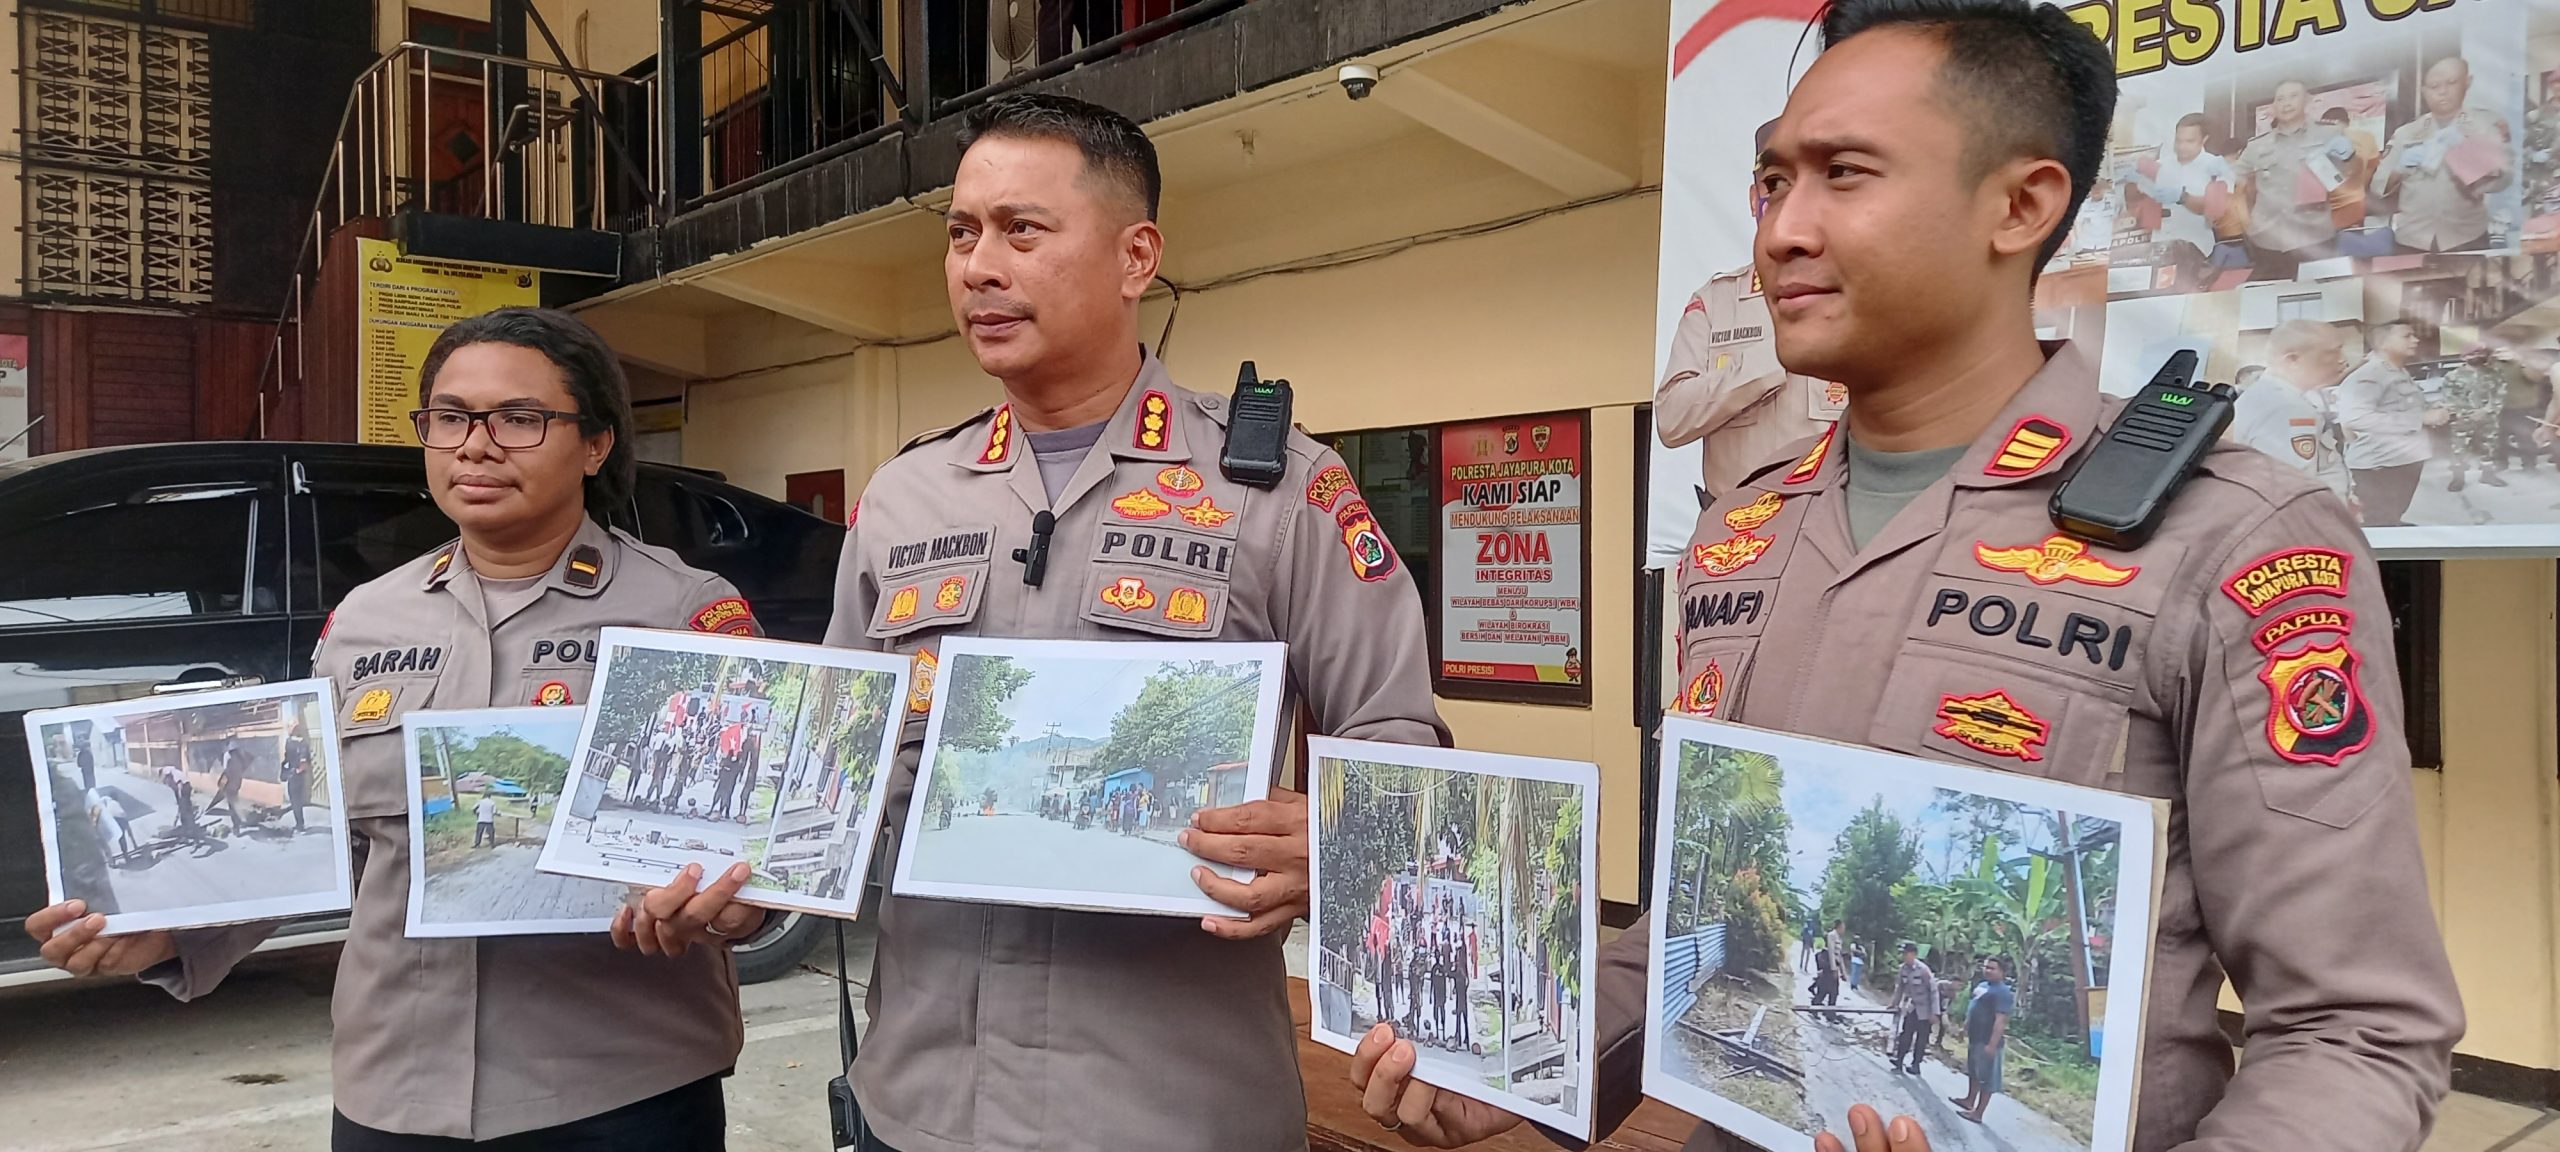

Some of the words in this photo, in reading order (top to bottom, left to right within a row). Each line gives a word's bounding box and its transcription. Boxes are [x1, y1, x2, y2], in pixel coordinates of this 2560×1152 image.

[1451, 463, 1496, 481] POLRESTA
[1499, 460, 1547, 477] JAYAPURA
[1548, 458, 1574, 475] KOTA
[1463, 482, 1512, 506] KAMI
[1517, 479, 1561, 504] SIAP
[1339, 503, 1365, 522] PAPUA
[1451, 511, 1508, 528] MENDUKUNG
[1510, 507, 1580, 526] PELAKSANAAN
[888, 541, 928, 569] VICTOR
[929, 532, 988, 561] MACKBON
[1101, 531, 1229, 573] POLRI
[1476, 531, 1552, 564] ZONA
[1476, 568, 1552, 581] INTEGRITAS
[2234, 553, 2342, 598] POLRESTA
[1497, 586, 1527, 596] MENUJU
[2249, 571, 2309, 608] JAYAPURA
[1479, 621, 1508, 630] WILAYAH
[1927, 588, 2132, 671] POLRI
[2265, 612, 2342, 642] PAPUA
[353, 646, 442, 681] SARAH
[1445, 664, 1466, 674] POLRI
[1467, 664, 1495, 675] PRESISI
